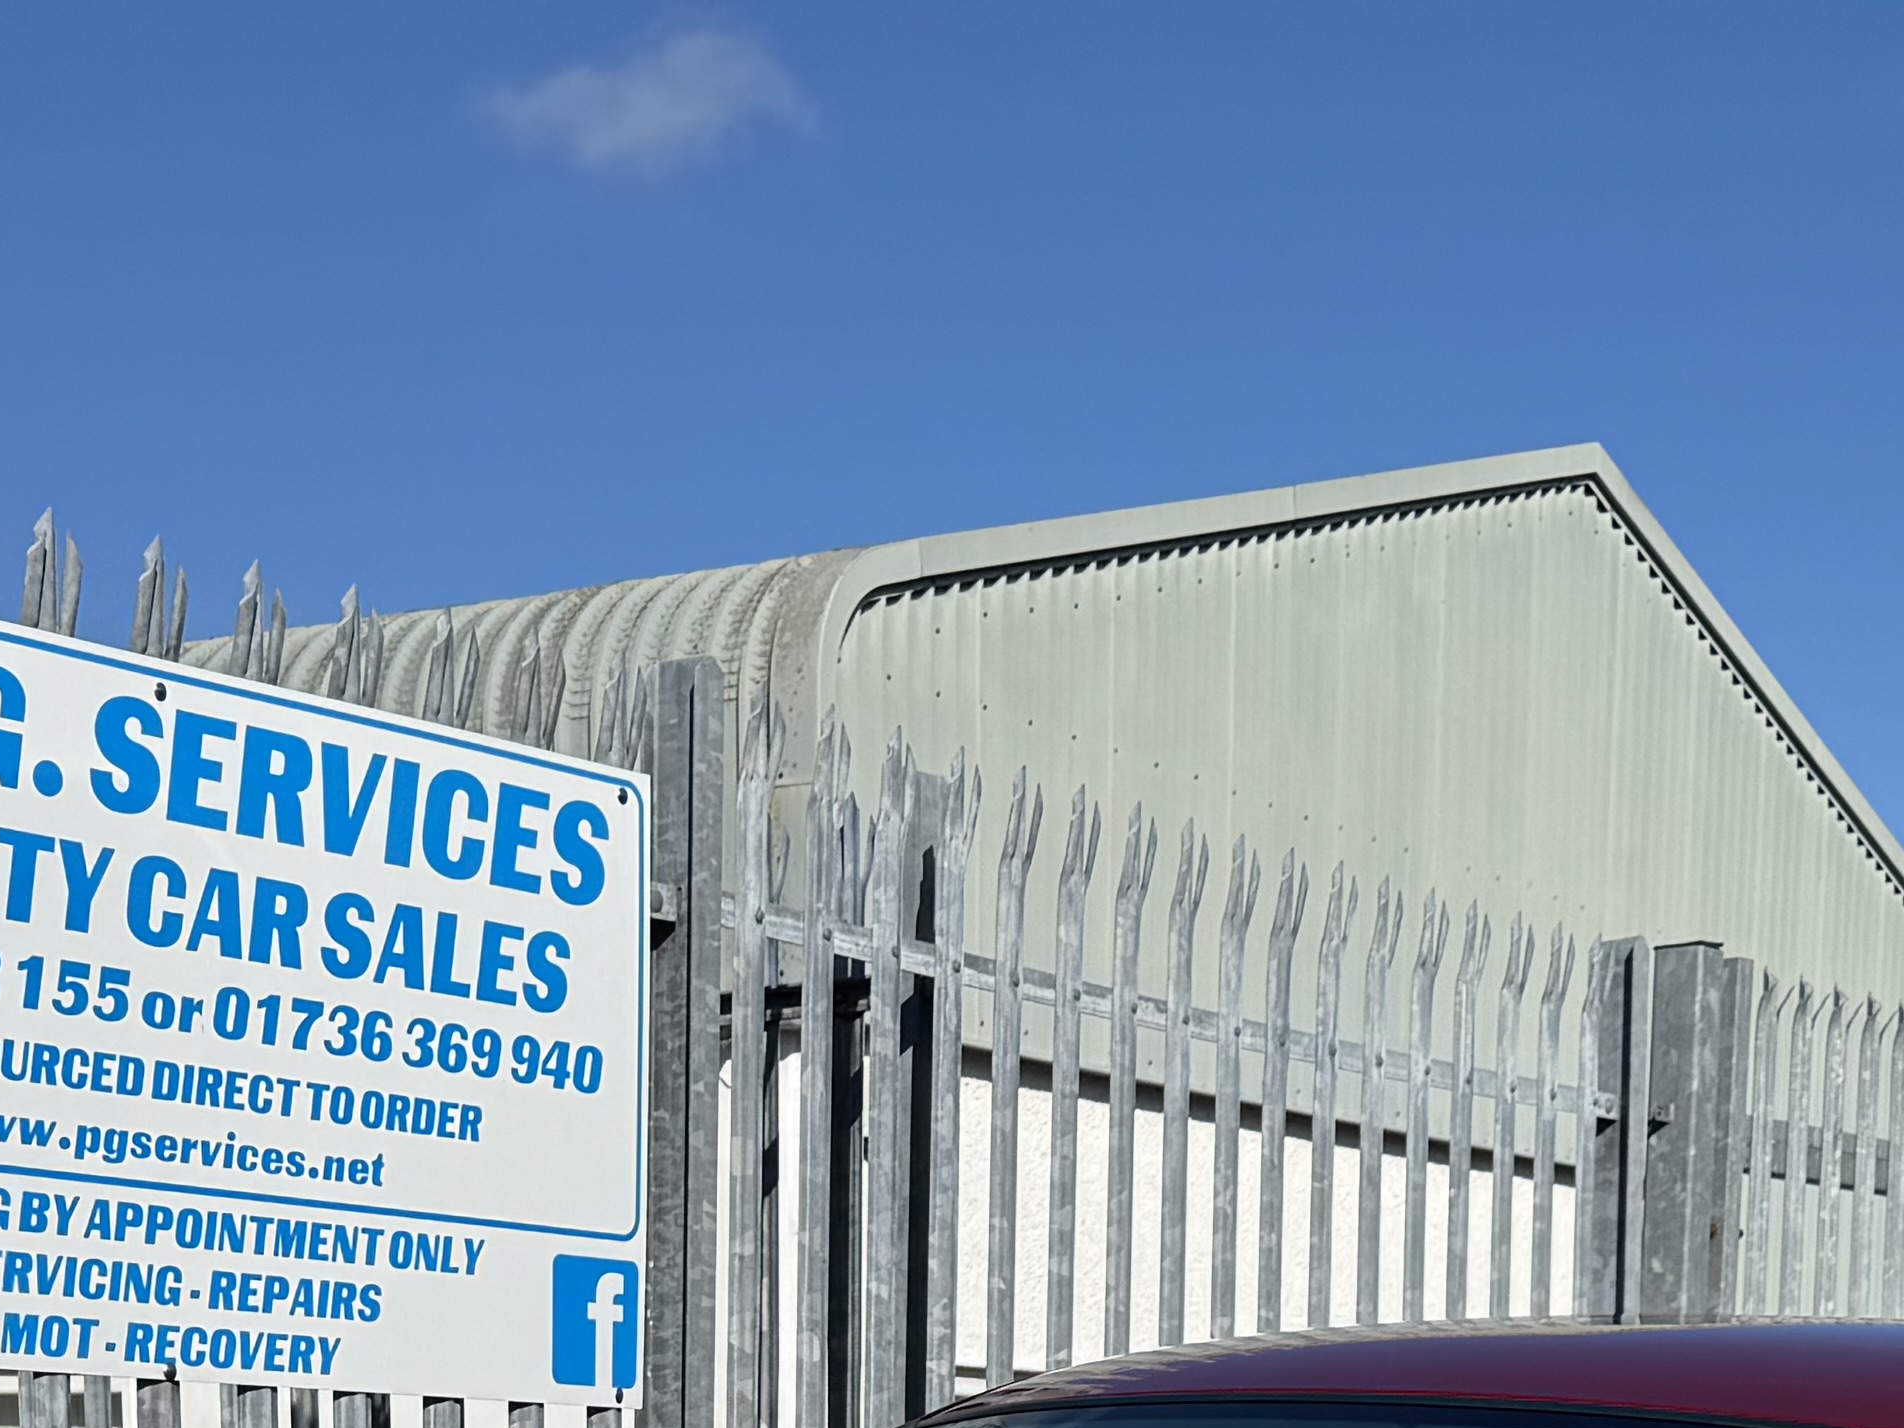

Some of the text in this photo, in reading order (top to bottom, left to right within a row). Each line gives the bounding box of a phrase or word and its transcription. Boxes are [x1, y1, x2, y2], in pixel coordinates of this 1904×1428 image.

[90, 696, 609, 906] SERVICES
[127, 856, 308, 970] CAR
[321, 893, 571, 1013] SALES
[18, 956, 131, 1022] 155
[142, 992, 203, 1033] or
[213, 987, 393, 1062] 01736
[403, 1018, 502, 1079] 369
[512, 1035, 603, 1094] 940
[152, 1061, 300, 1117] DIRECT
[308, 1083, 355, 1125] TO
[360, 1091, 482, 1142] ORDER
[19, 1192, 79, 1236] BY
[86, 1199, 384, 1266] APPOINTMENT
[390, 1231, 483, 1276] ONLY
[209, 1271, 381, 1323] REPAIRS
[2, 1313, 99, 1359] MOT
[125, 1323, 339, 1375] RECOVERY
